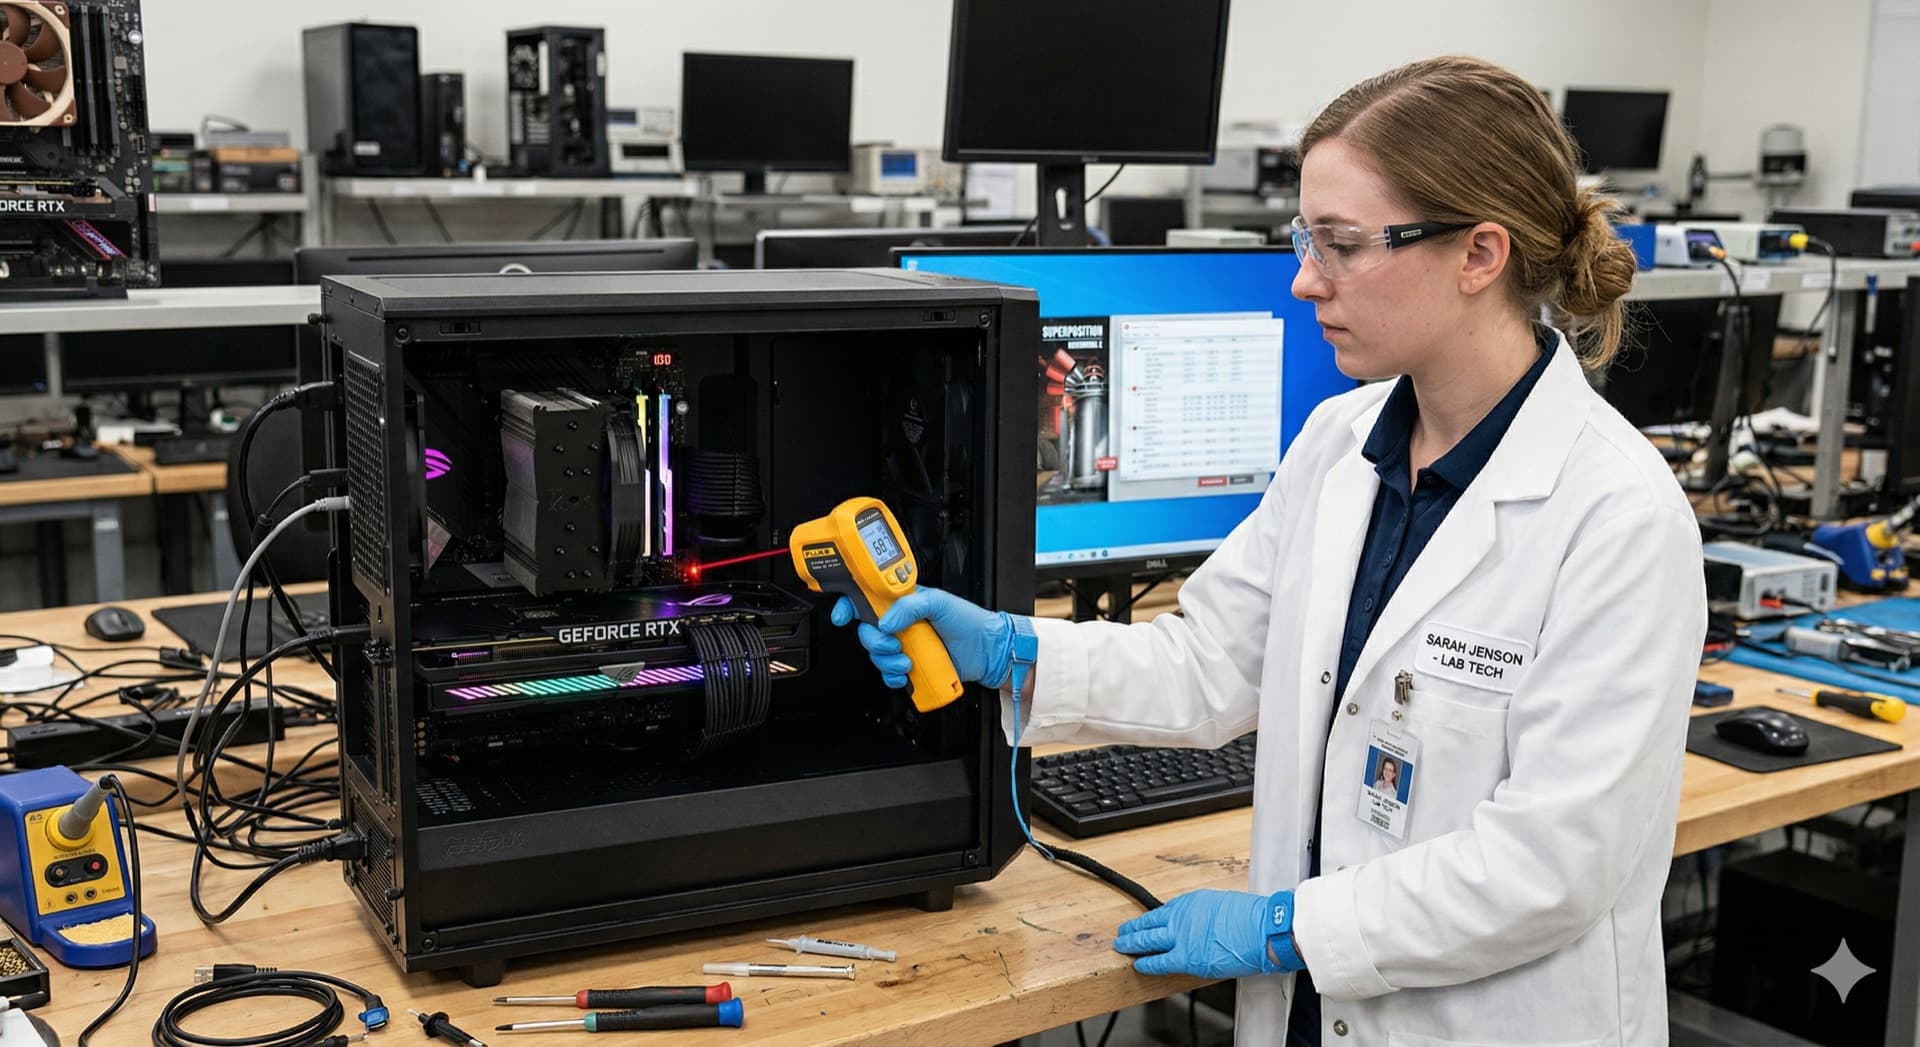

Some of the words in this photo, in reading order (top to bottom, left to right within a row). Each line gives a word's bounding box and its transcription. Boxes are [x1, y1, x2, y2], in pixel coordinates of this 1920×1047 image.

[37, 200, 65, 212] RTX
[558, 623, 641, 644] GEFORCE
[645, 620, 681, 637] RTX
[1426, 633, 1467, 654] SARAH
[1468, 644, 1523, 666] JENSON
[1440, 653, 1465, 670] LAB
[1468, 660, 1504, 679] TECH
